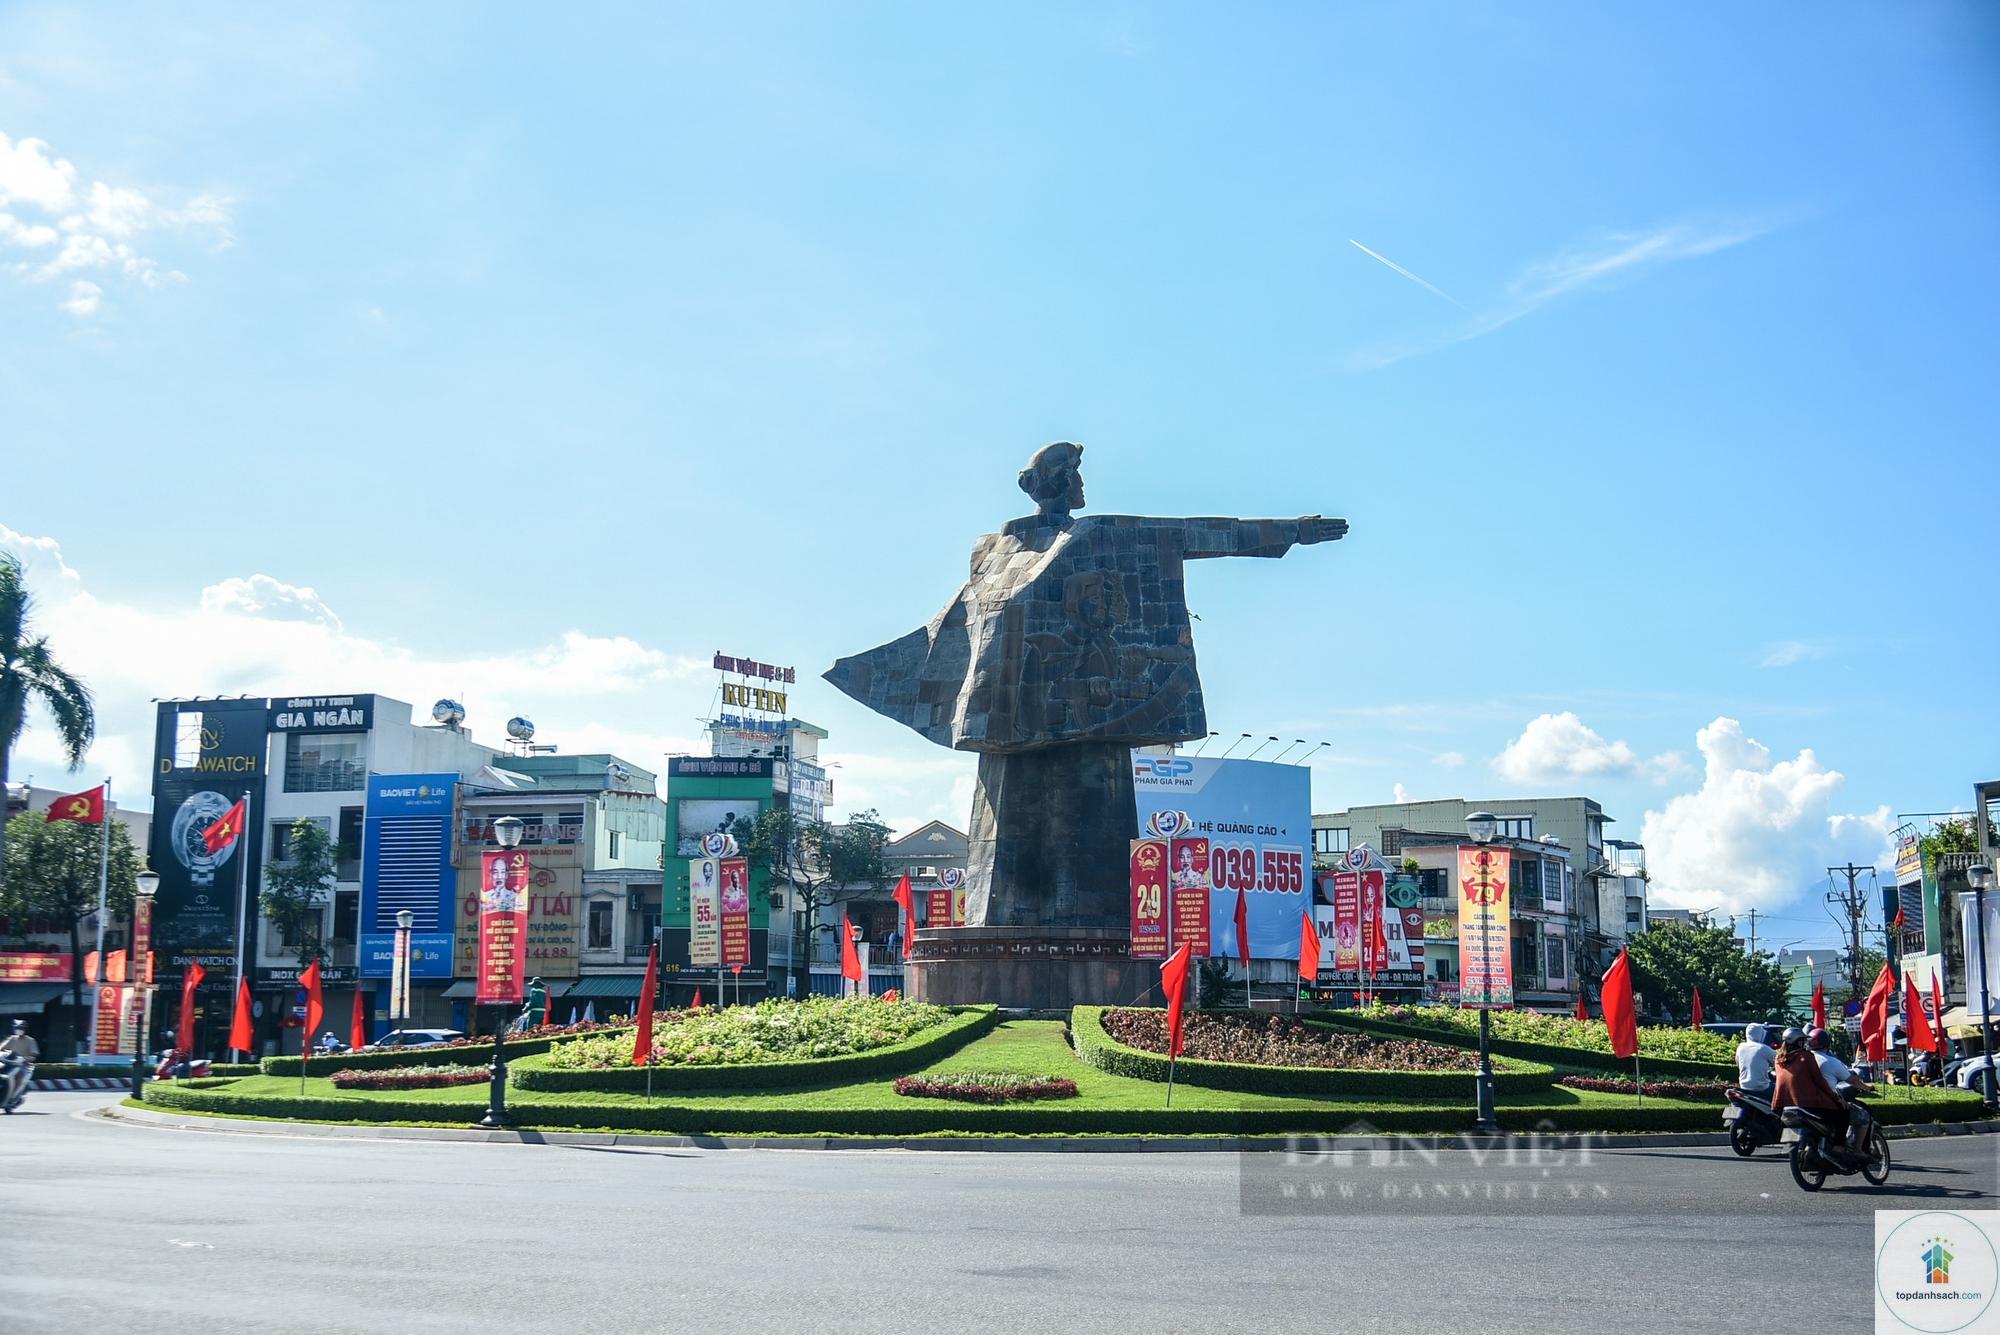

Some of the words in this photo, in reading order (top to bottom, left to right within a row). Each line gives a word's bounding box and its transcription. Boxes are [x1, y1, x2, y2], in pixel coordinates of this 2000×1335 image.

[775, 667, 783, 680] &
[314, 698, 327, 706] TY
[276, 712, 307, 728] GIA
[313, 707, 364, 726] NGÂN
[739, 763, 748, 772] &
[380, 788, 417, 797] BAOVIET
[431, 788, 446, 796] Life
[1199, 821, 1213, 834] HỆ
[1257, 824, 1277, 836] CÁO
[1211, 847, 1304, 894] 039.555
[1472, 886, 1495, 903] 79
[543, 891, 572, 916] LÁI
[697, 905, 710, 922] 55
[425, 952, 439, 960] Life
[271, 970, 294, 979] INOX
